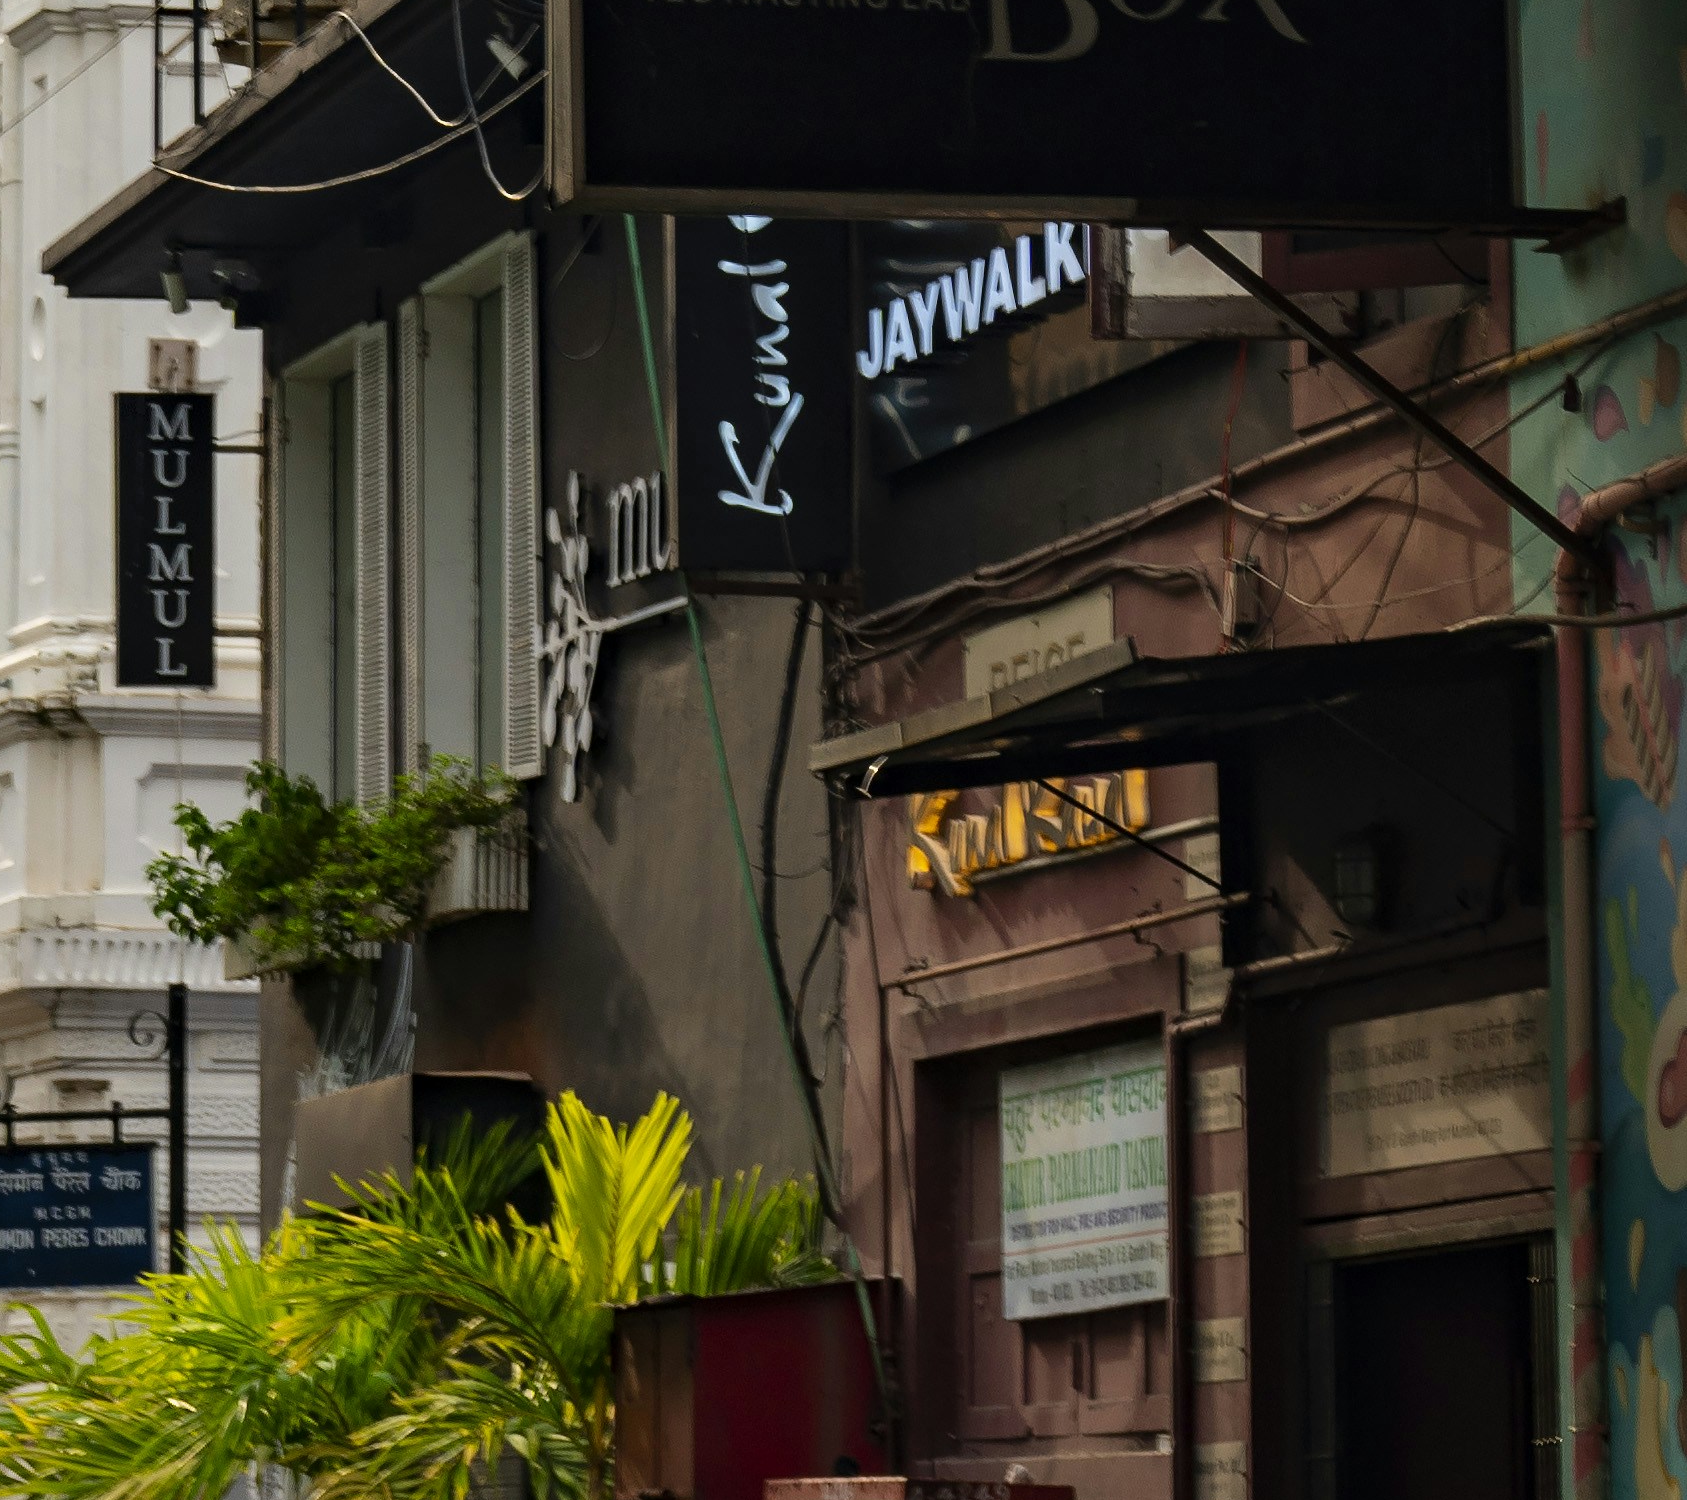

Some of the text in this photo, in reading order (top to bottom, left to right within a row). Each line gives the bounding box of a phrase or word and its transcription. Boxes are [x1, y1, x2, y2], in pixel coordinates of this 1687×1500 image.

[855, 221, 1091, 380] JAYWALK
[147, 403, 194, 677] MULMUL
[40, 1227, 90, 1249] PERES
[93, 1226, 147, 1248] CHOWK
